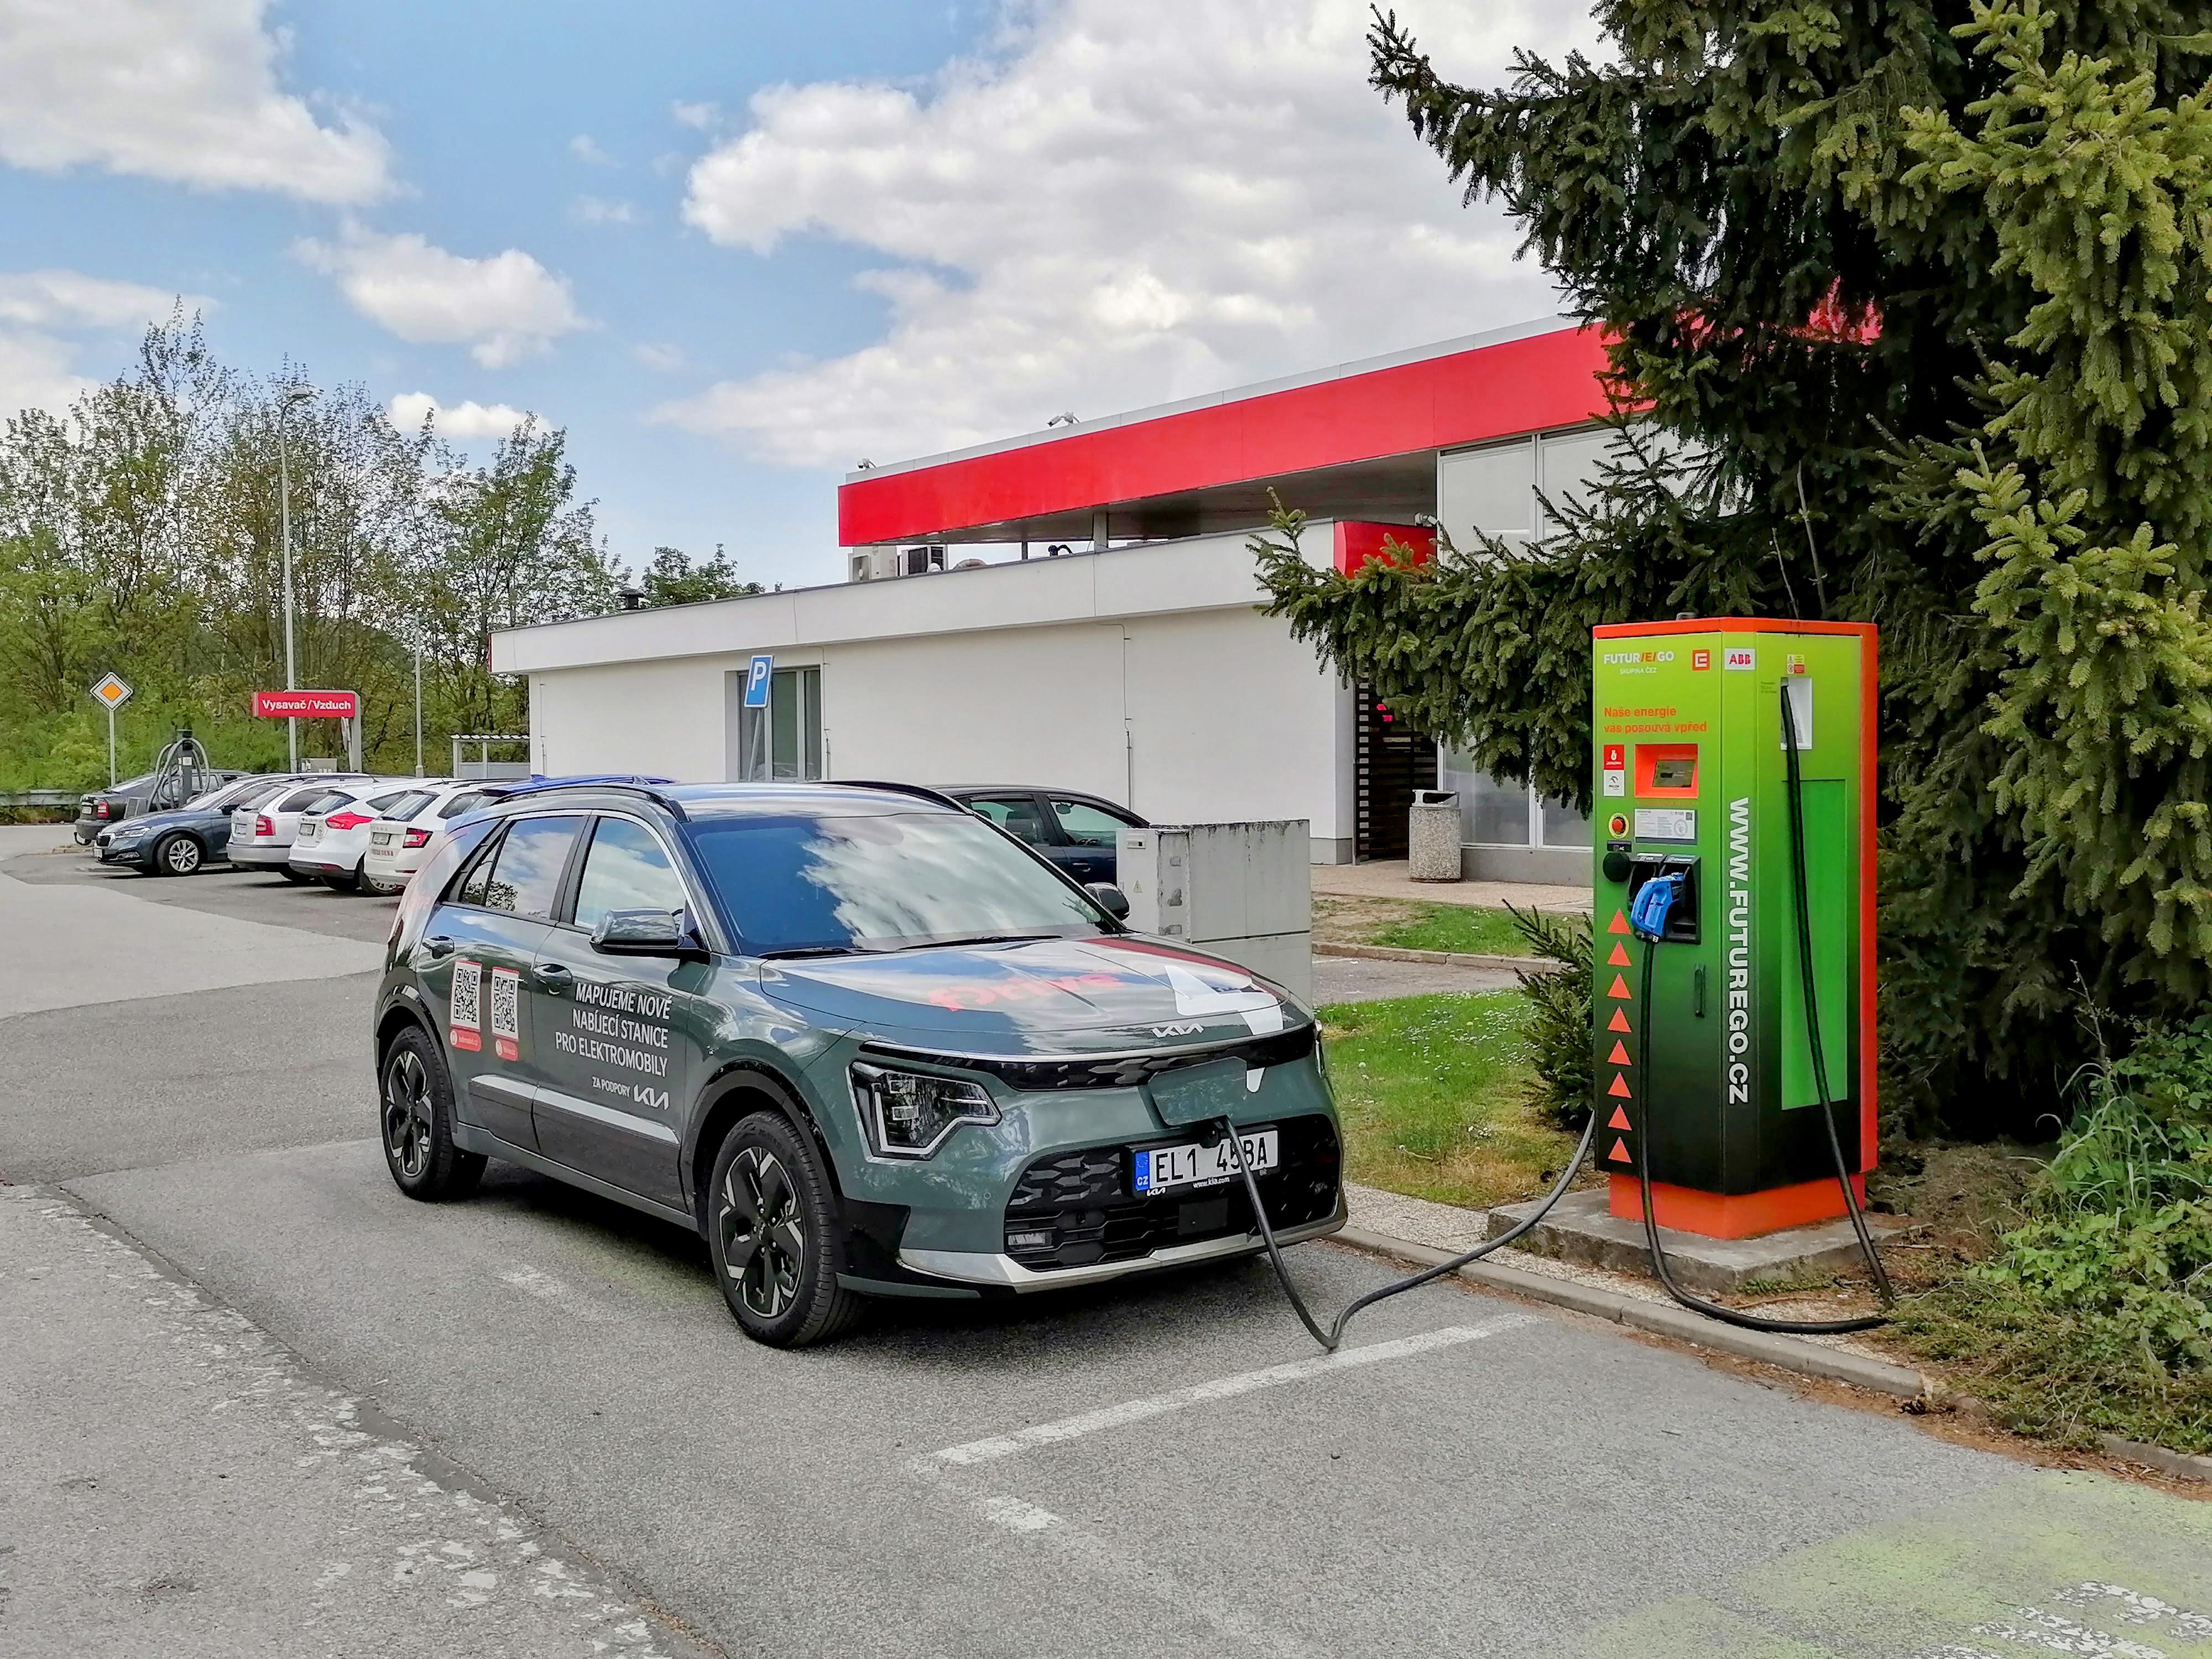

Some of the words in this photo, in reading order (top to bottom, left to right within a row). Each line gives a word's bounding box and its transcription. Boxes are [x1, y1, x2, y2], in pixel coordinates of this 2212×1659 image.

[1604, 651, 1674, 665] FUTUR/E/GO
[1728, 654, 1751, 665] ABB
[750, 661, 767, 691] P
[1604, 706, 1631, 718] Naše
[1634, 705, 1677, 719] energie
[1604, 722, 1623, 733] vás
[1625, 722, 1671, 734] posouvá
[1674, 721, 1708, 734] vpřed
[1729, 796, 1749, 1105] WWW.FUTUREGO.CZ
[575, 982, 636, 1013] MAPUJEME
[637, 995, 673, 1020] NOVÉ
[572, 1008, 620, 1037] NABÍJECÍ
[620, 1020, 669, 1049] STANICE
[1151, 1023, 1204, 1038] KIA
[555, 1031, 577, 1053] PRO
[578, 1037, 668, 1078] ELEKTROMOBILY
[592, 1076, 601, 1089] ZA
[601, 1080, 630, 1098] PODPORY
[633, 1084, 670, 1110] KIA
[1136, 1173, 1149, 1187] CZ
[1155, 1147, 1198, 1183] EL1
[1192, 1177, 1230, 1188] www.kia.com
